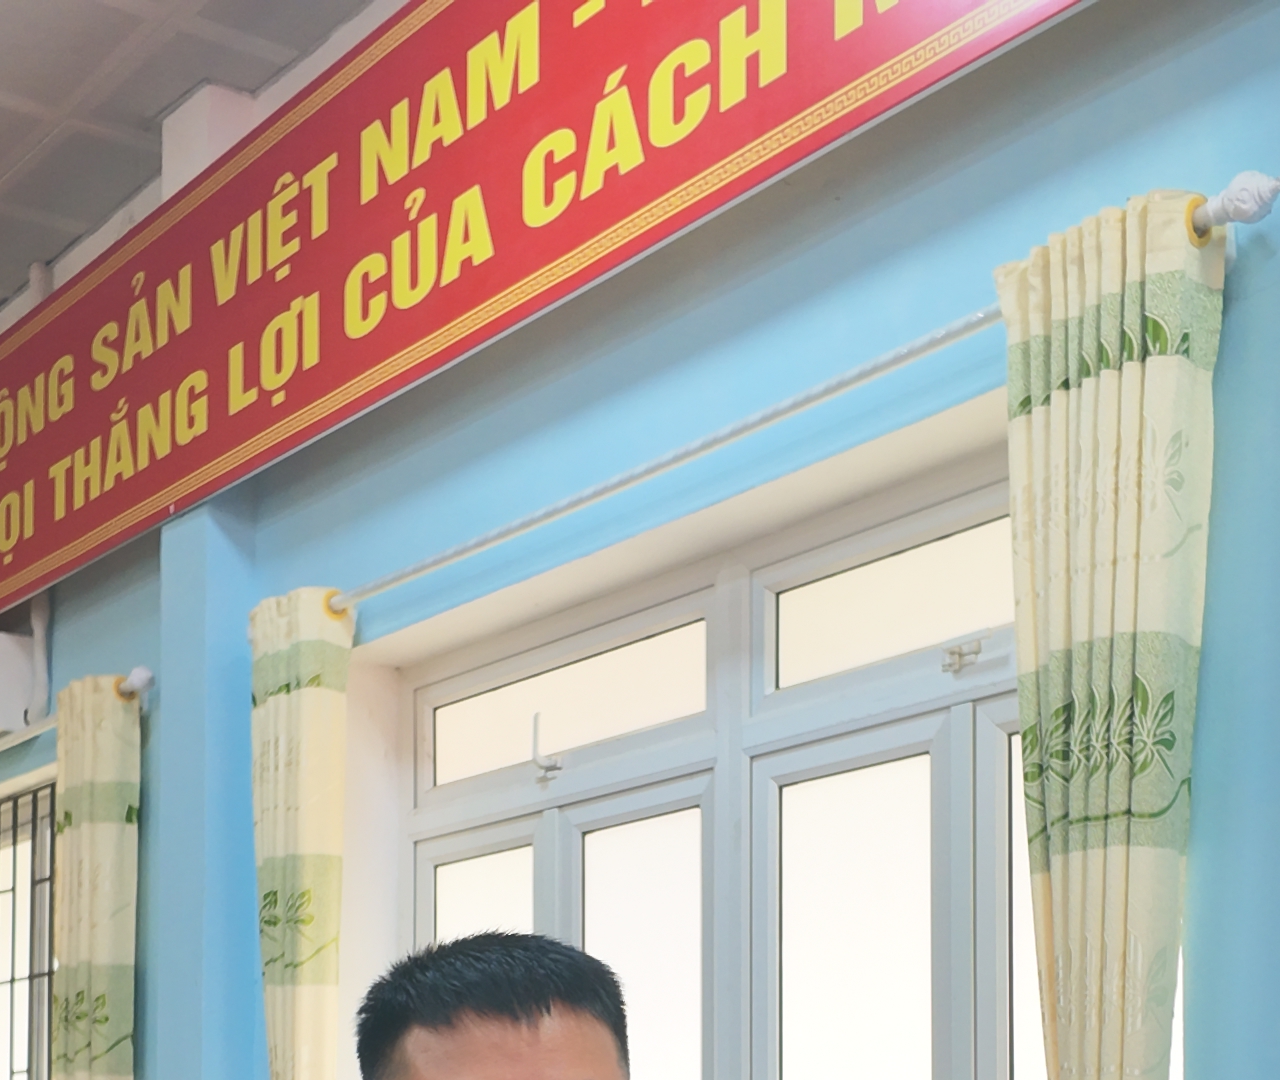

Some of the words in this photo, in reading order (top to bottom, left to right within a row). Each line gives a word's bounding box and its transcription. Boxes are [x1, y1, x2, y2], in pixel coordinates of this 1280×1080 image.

[48, 369, 208, 521] THẮNG
[228, 291, 320, 416] LỢI
[344, 184, 494, 340] CỦA
[521, 0, 788, 228] CÁCH
[90, 264, 192, 390] SẢN
[210, 153, 338, 306] VIỆT
[360, 0, 540, 204] NAM
